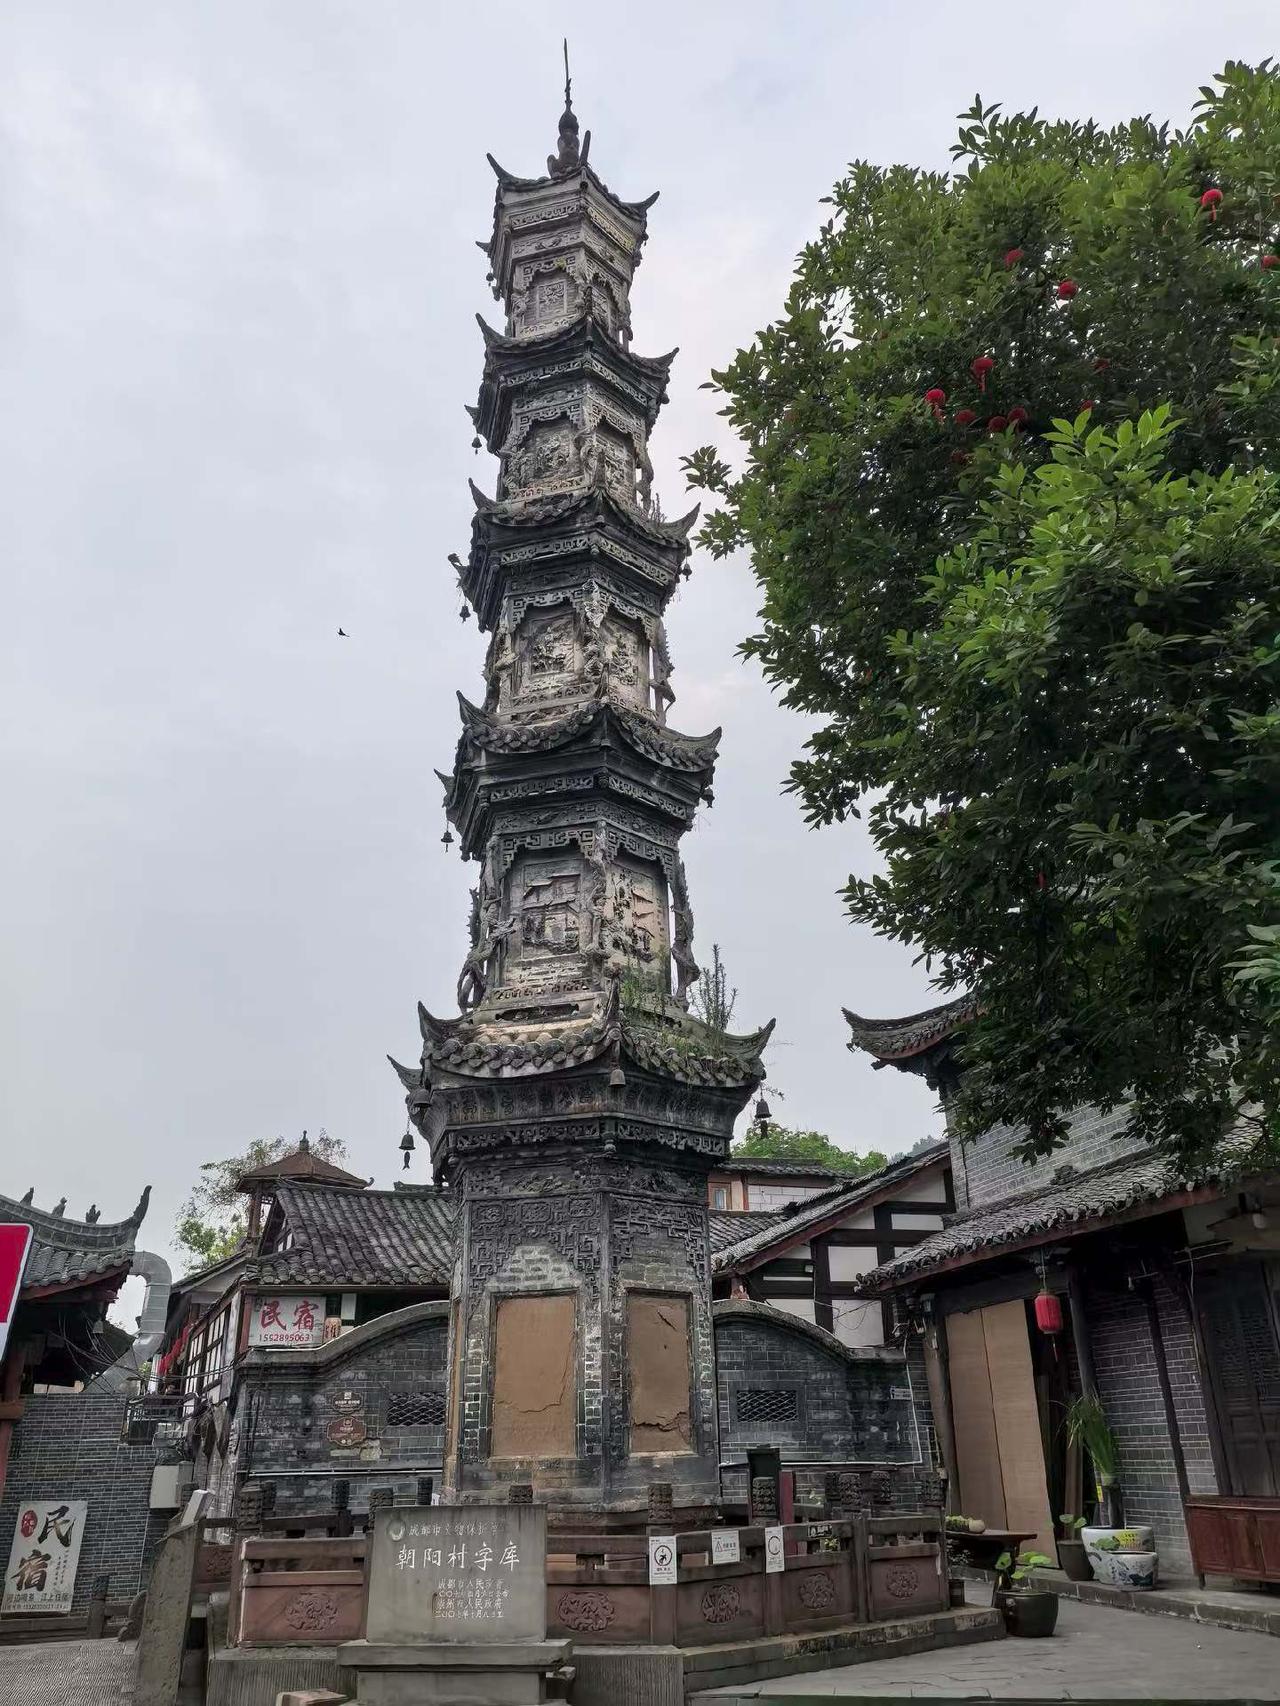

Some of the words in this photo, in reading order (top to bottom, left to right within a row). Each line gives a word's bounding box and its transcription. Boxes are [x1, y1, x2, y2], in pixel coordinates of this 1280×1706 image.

[261, 1300, 319, 1331] 民宿
[409, 1522, 504, 1536] 成都市文物保护单
[10, 1505, 76, 1591] 民宿
[395, 1540, 520, 1571] 朝阳村字库
